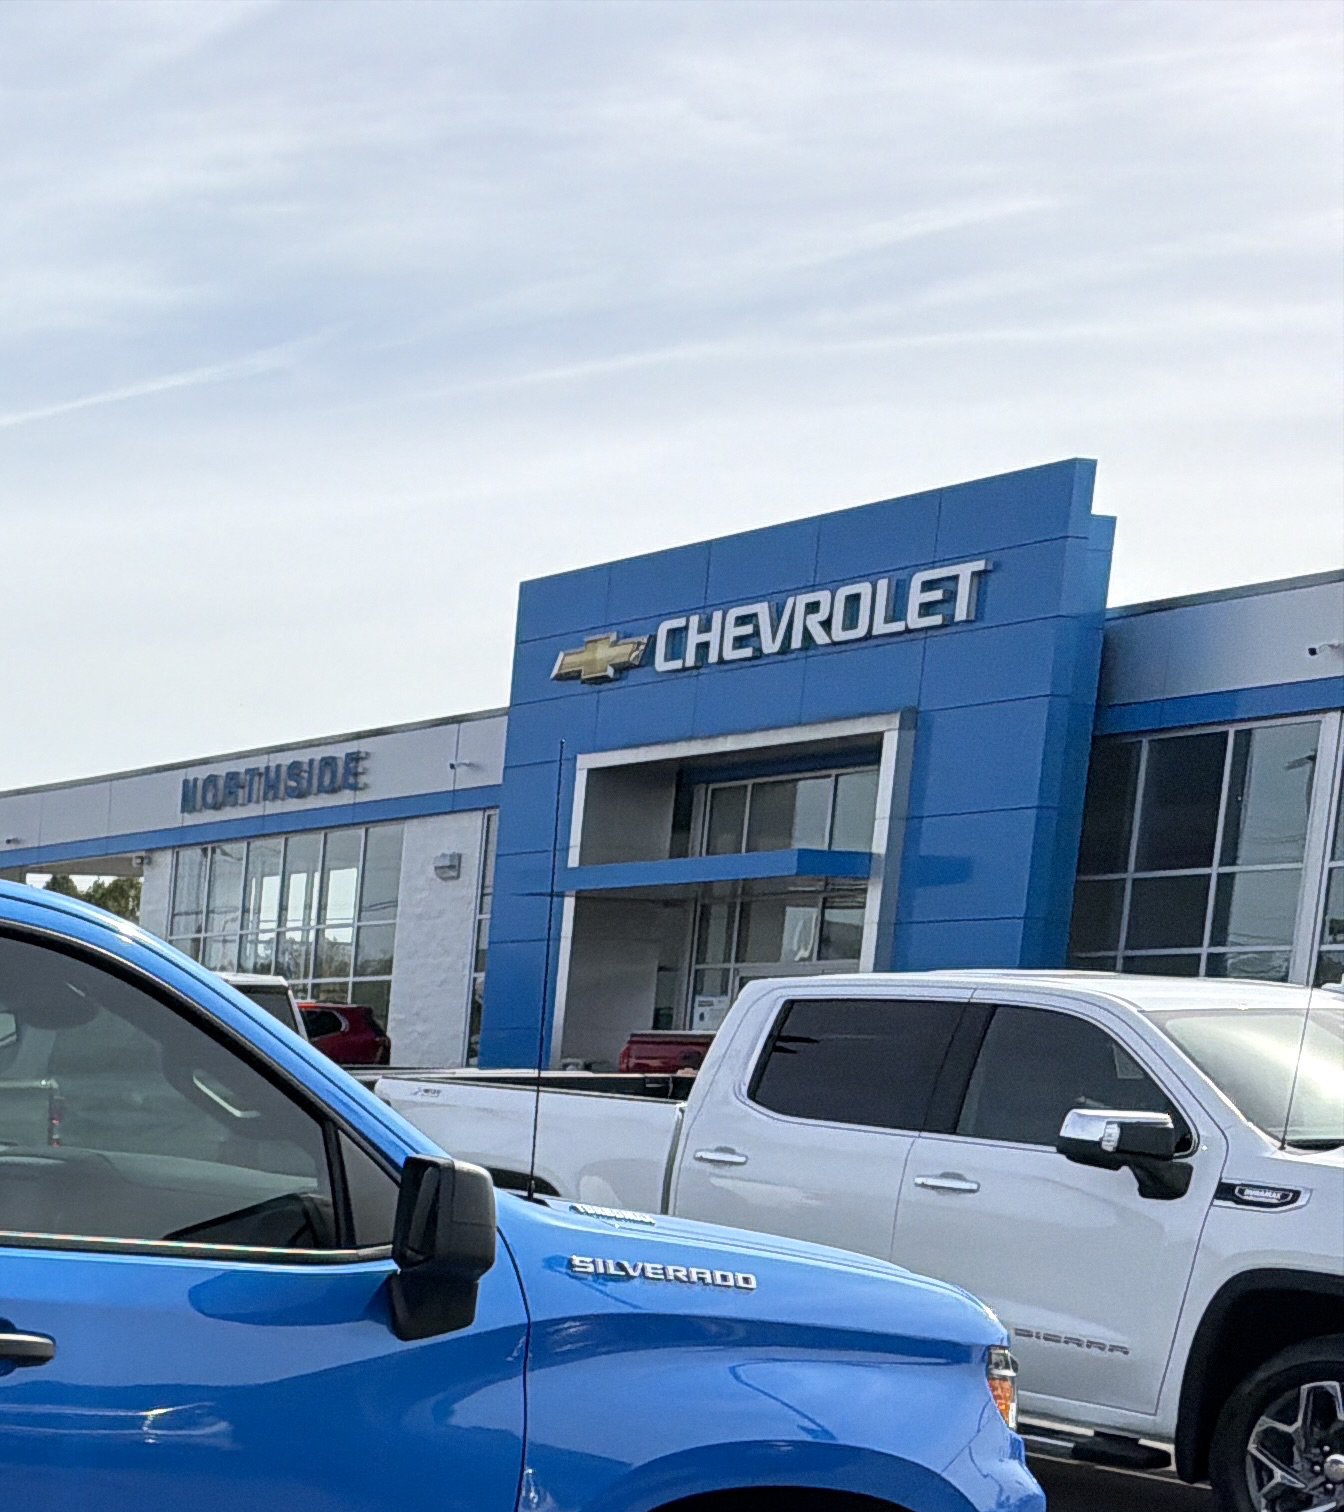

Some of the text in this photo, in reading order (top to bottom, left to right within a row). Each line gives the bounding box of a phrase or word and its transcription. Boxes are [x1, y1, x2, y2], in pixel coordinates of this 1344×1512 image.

[654, 559, 994, 673] CHEVROLET
[180, 750, 371, 814] NORTHSIDE
[569, 1254, 758, 1290] SILVERADO
[1014, 1327, 1130, 1356] SIERRA
